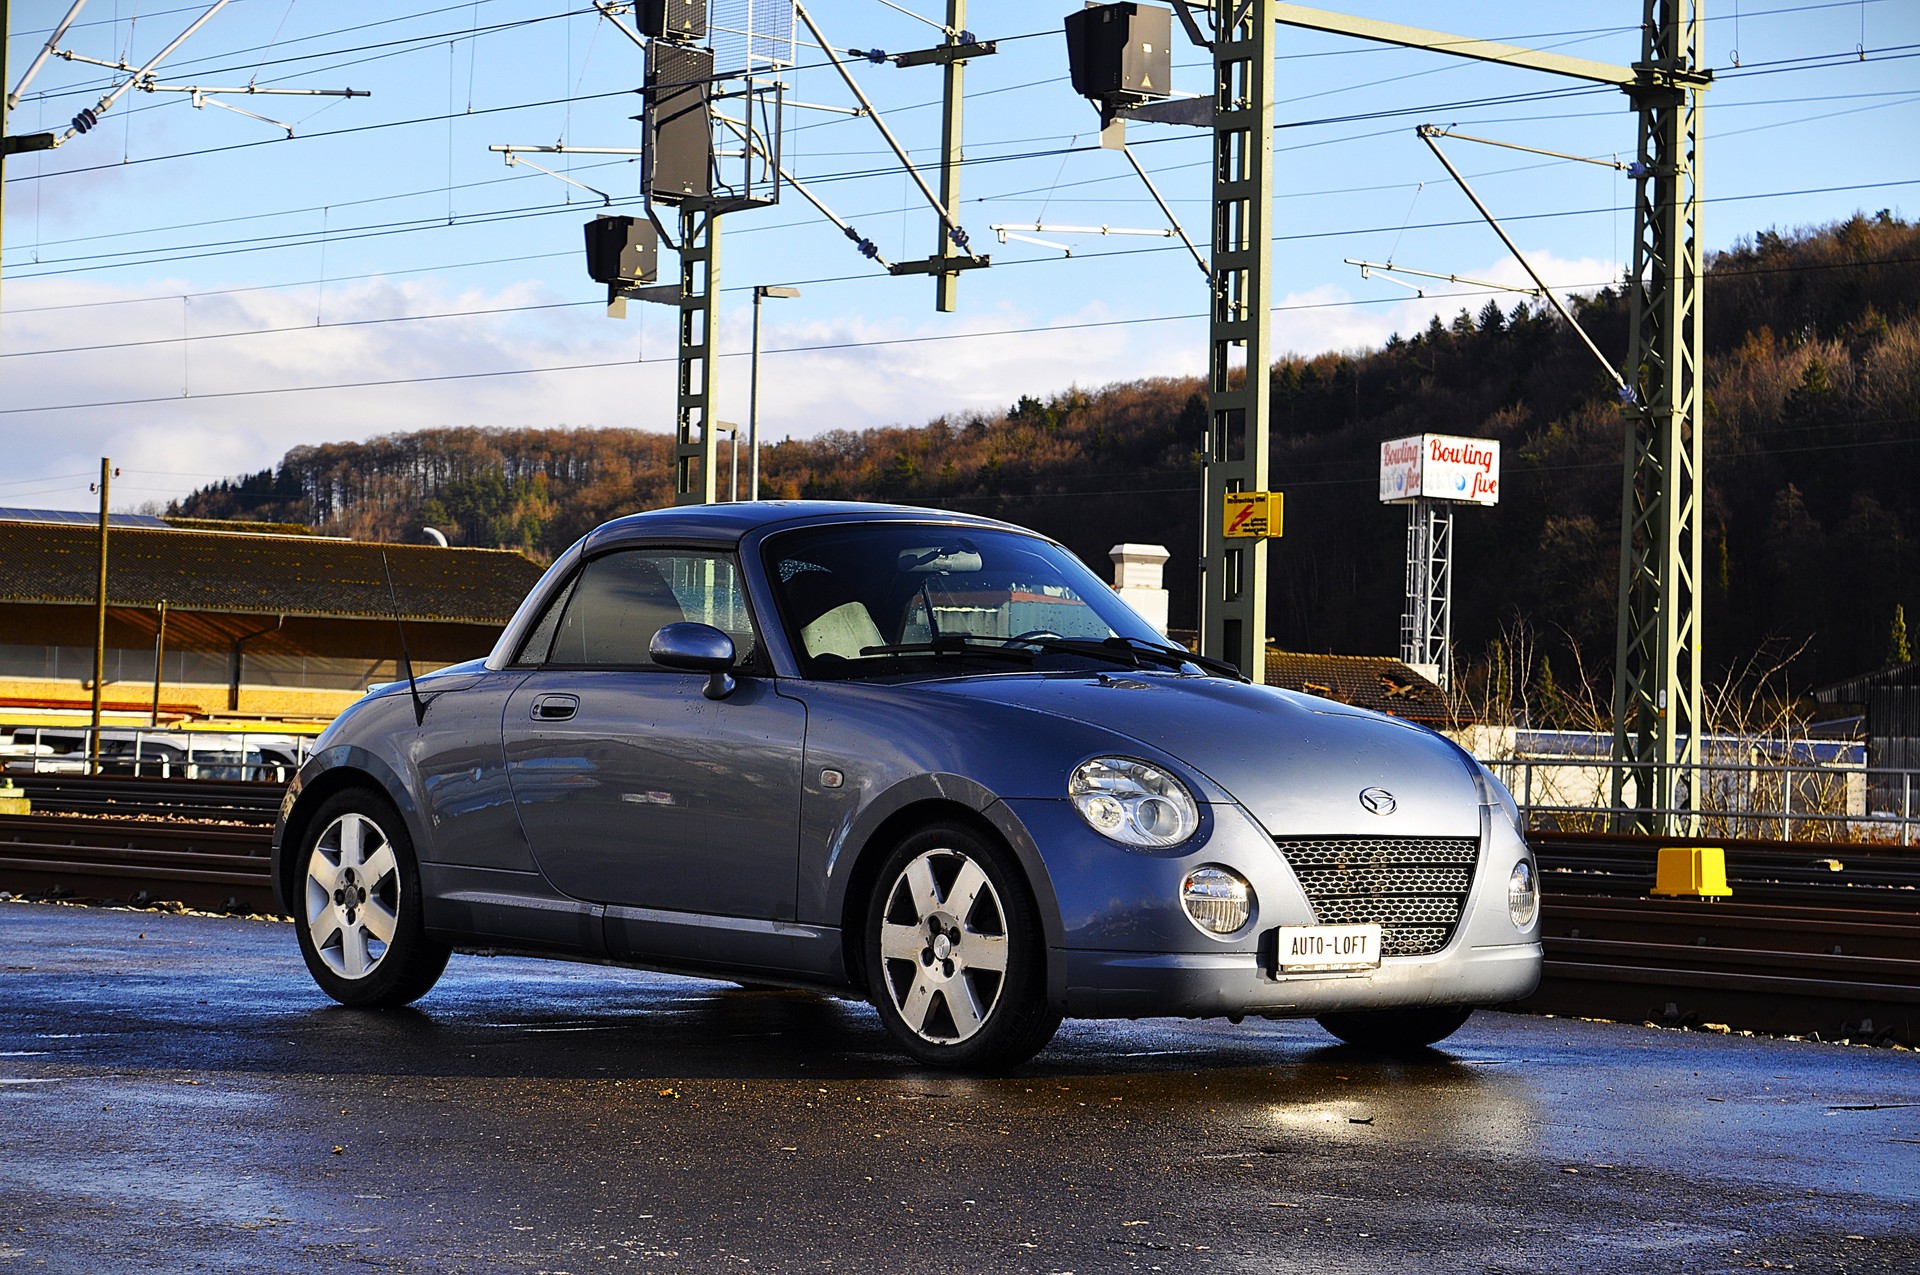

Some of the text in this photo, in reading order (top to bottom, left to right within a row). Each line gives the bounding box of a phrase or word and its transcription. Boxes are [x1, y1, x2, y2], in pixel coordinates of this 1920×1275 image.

[1383, 441, 1418, 468] Bowling
[1430, 438, 1493, 473] Bowling
[1405, 467, 1420, 496] five
[1470, 472, 1497, 498] five
[1291, 936, 1367, 955] AUTO-LOFT
